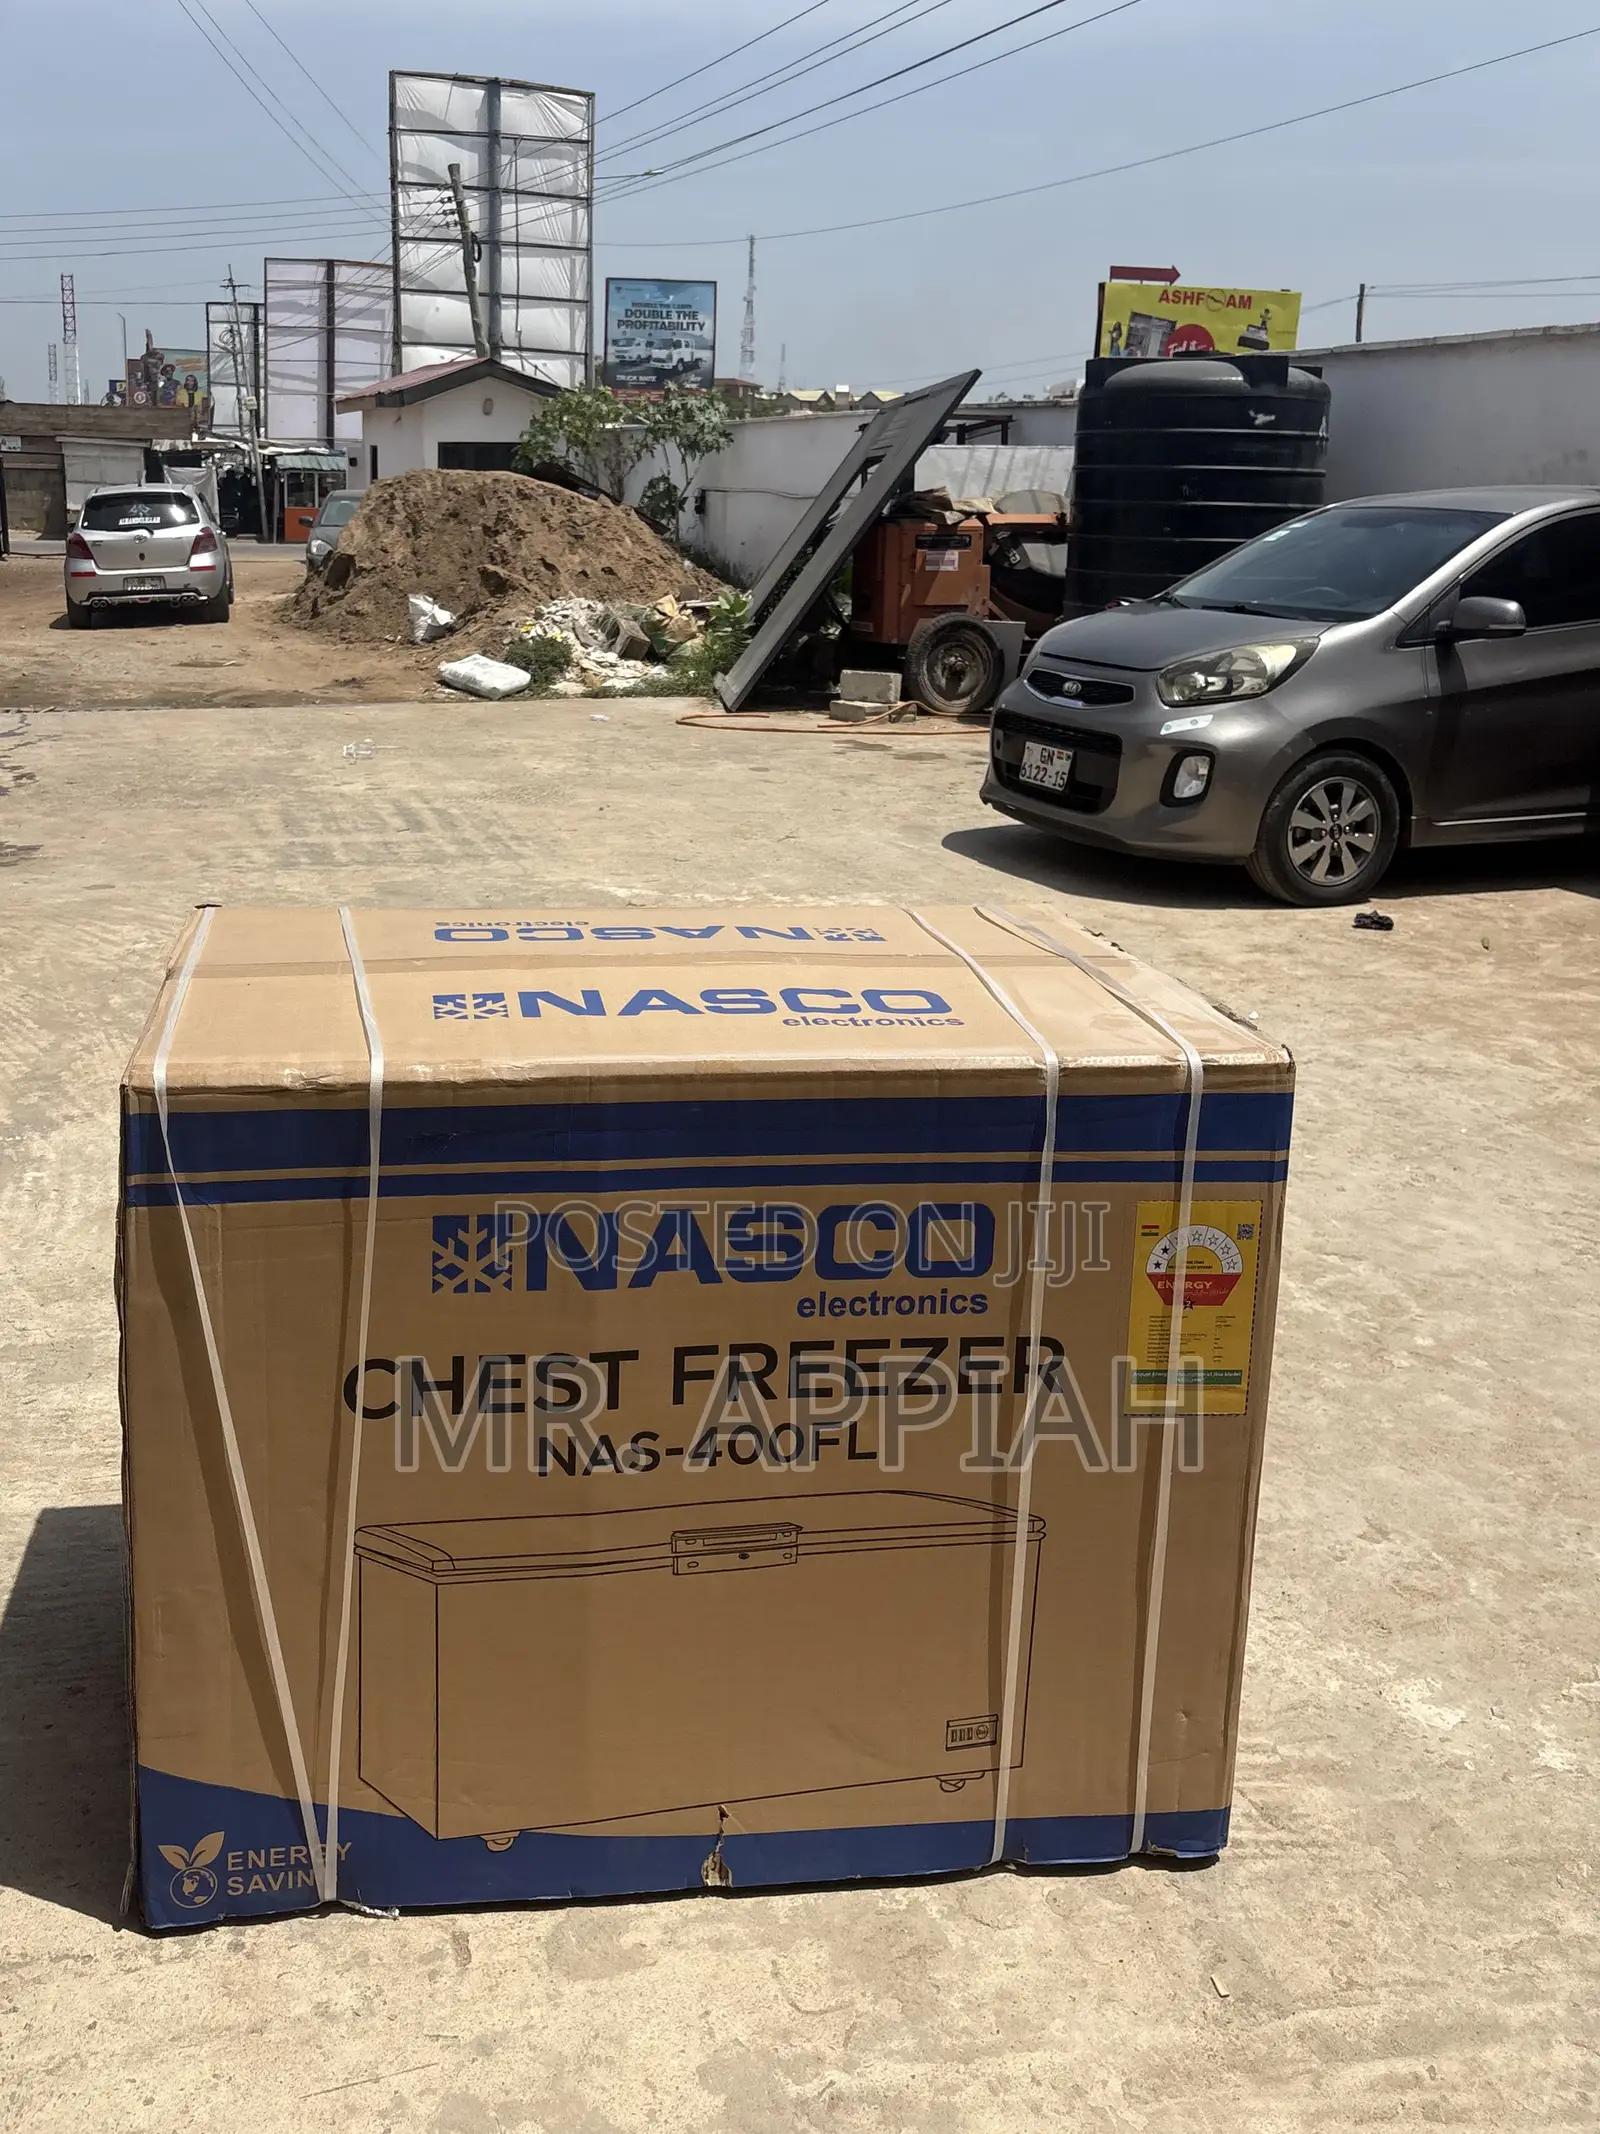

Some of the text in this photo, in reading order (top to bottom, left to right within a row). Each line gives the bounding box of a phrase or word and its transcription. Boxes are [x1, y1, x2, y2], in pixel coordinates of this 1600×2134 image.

[624, 308, 700, 321] DOUBLE THE
[616, 319, 706, 332] PROFITABILITY
[1063, 682, 1082, 694] KIA
[1039, 747, 1056, 767] GN
[1020, 762, 1068, 789] 6122-15
[433, 924, 818, 943] NASCO
[435, 920, 590, 928] electronics
[518, 987, 953, 1018] NASCO
[781, 1014, 966, 1028] electronics
[526, 1202, 996, 1292] NASCO
[1156, 1280, 1214, 1291] ENRGY
[796, 1288, 989, 1318] electronics
[343, 1349, 640, 1420] CHEST
[672, 1335, 1066, 1406] FREEZER
[537, 1420, 878, 1478] NAS-400FL
[227, 1868, 318, 1897] SAVIN
